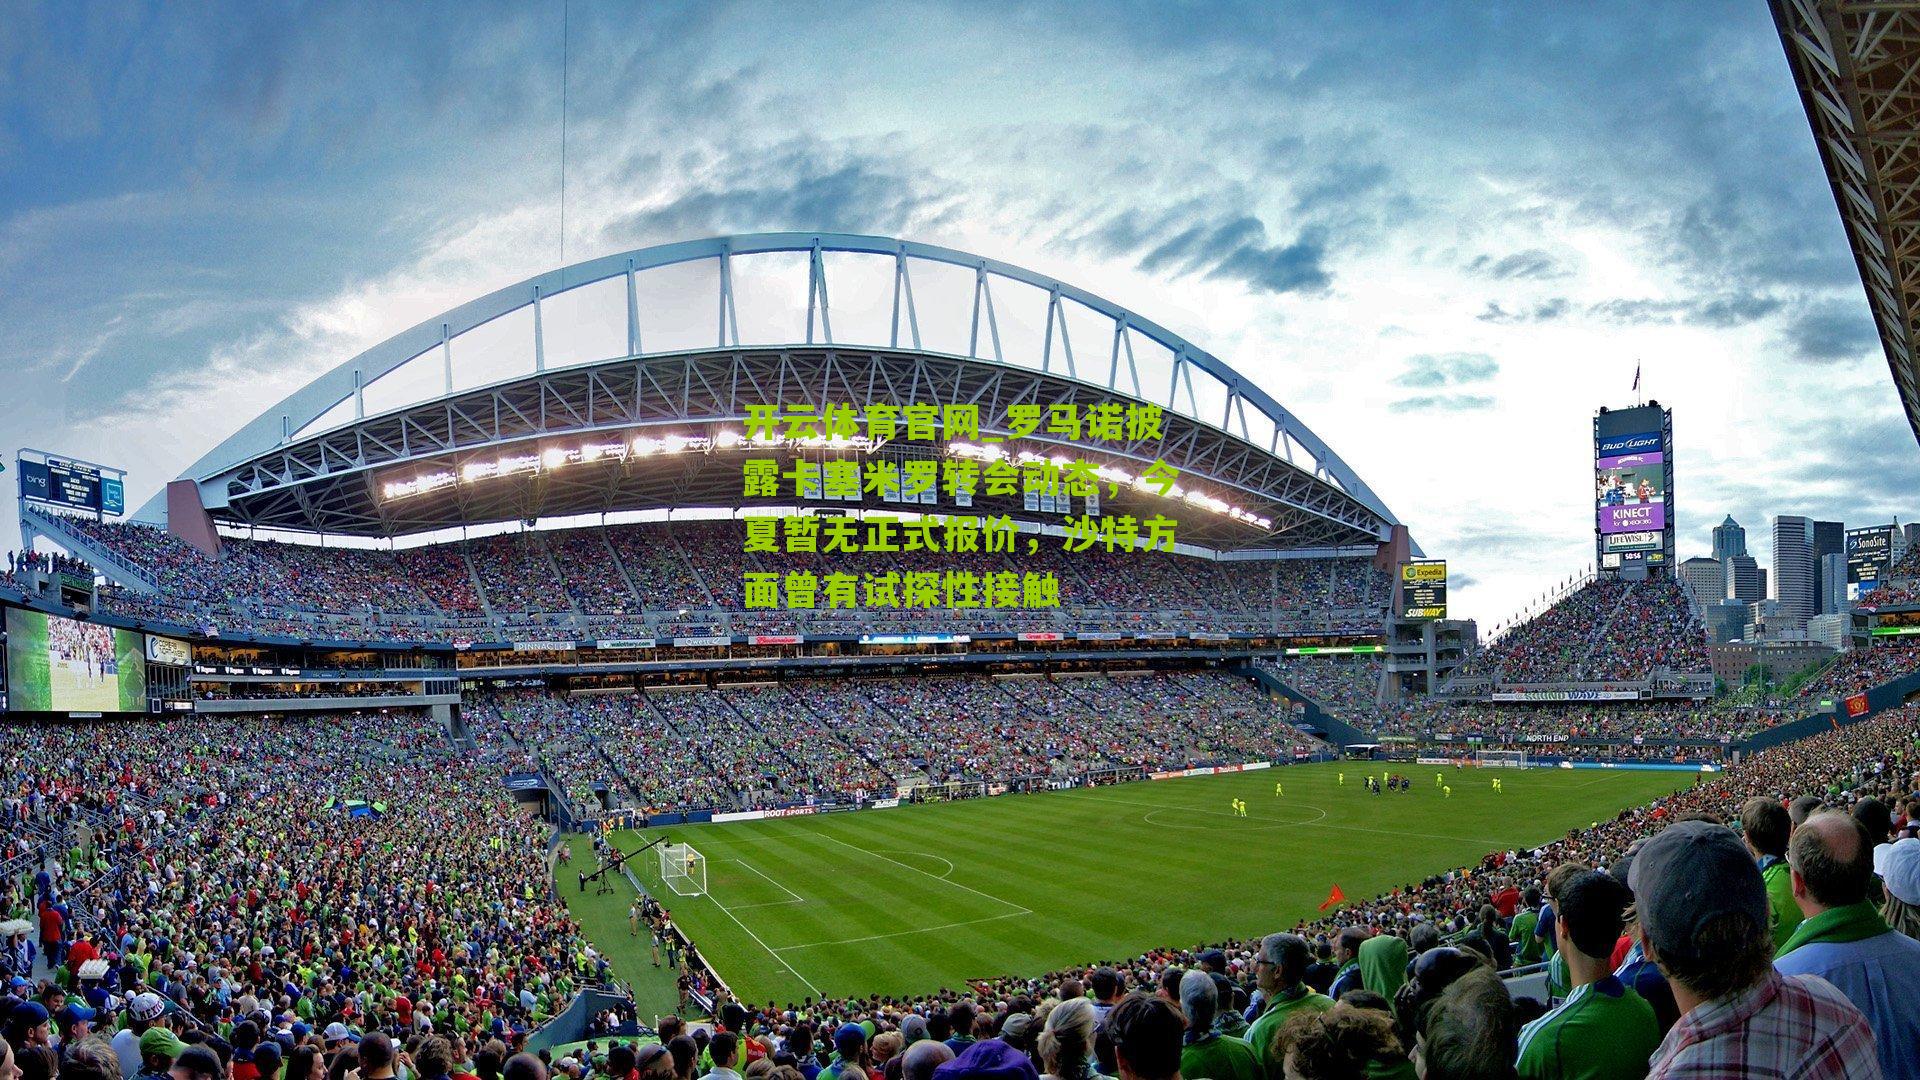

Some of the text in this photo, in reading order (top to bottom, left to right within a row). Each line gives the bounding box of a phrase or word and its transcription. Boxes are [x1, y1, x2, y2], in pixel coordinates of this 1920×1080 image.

[1602, 439, 1658, 450] BUD LIGHT
[26, 475, 46, 487] bing
[1613, 507, 1653, 519] KINECT
[1858, 536, 1886, 548] SonoSite
[1417, 568, 1442, 577] Expedia
[1405, 607, 1445, 618] SUBWAY
[1526, 734, 1570, 743] NORTH END
[764, 809, 787, 818] ROOT
[786, 807, 814, 816] SPORTS
